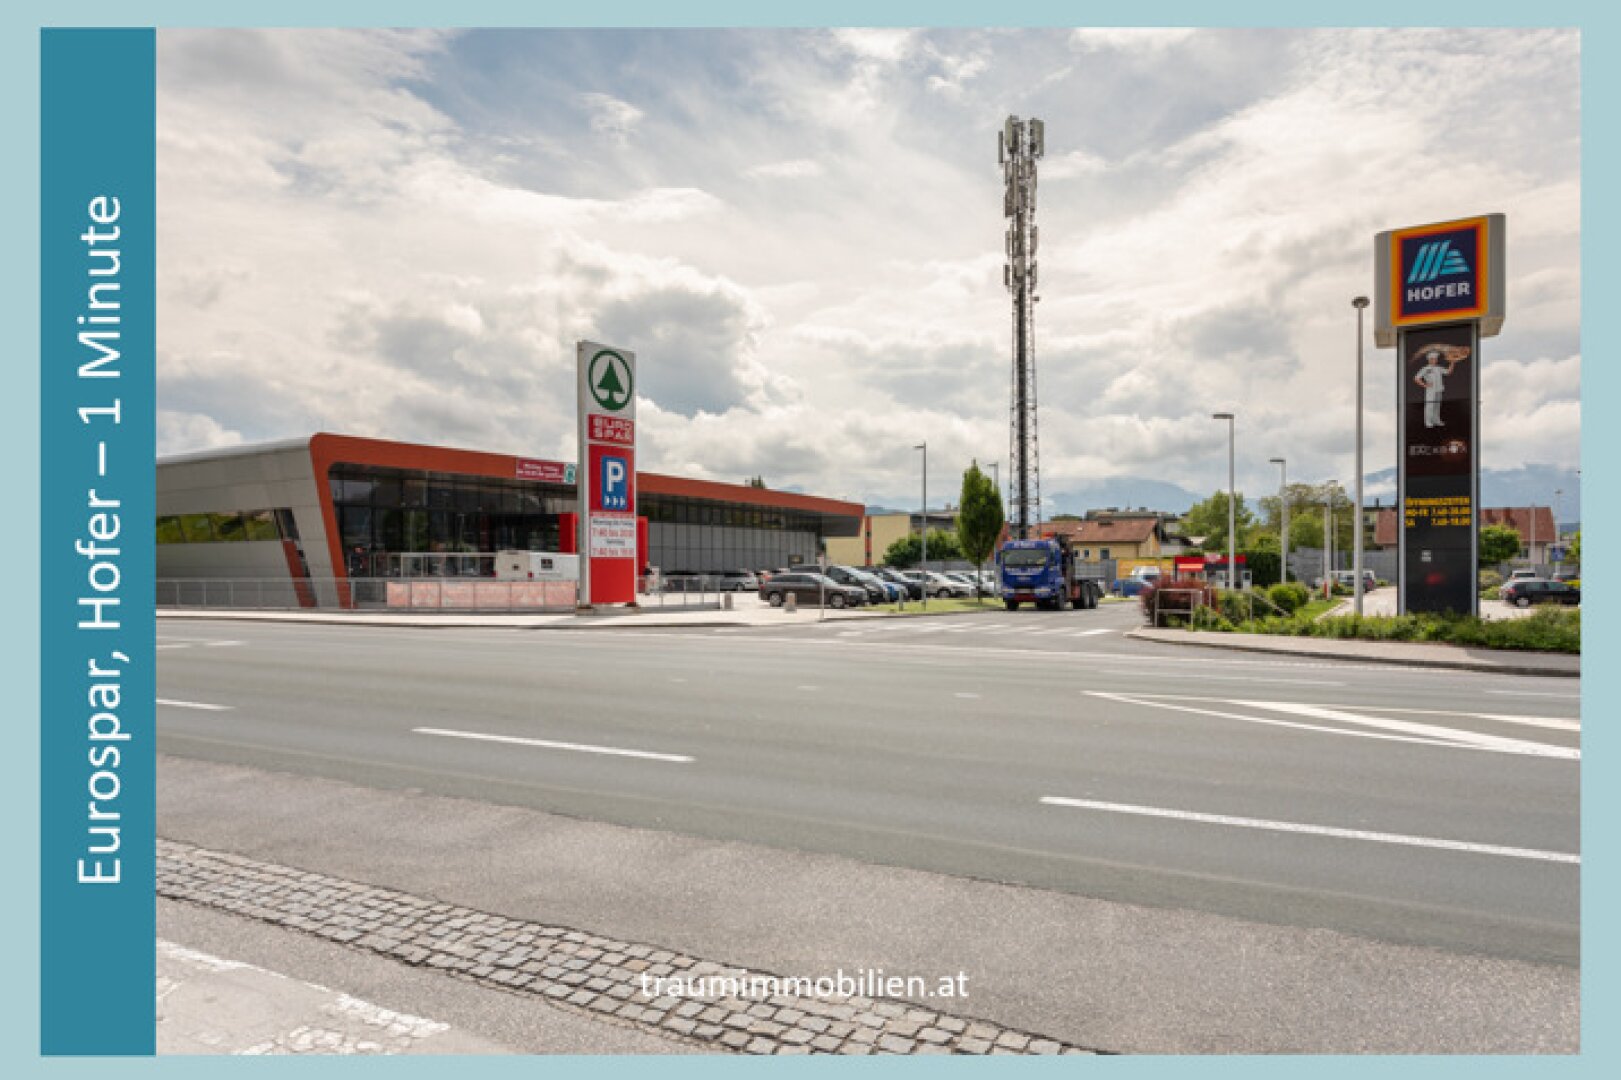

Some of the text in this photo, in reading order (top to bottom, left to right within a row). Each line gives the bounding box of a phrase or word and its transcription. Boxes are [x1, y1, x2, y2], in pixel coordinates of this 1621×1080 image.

[1407, 282, 1471, 302] HOFER
[592, 428, 632, 440] SPAR
[606, 461, 624, 492] P
